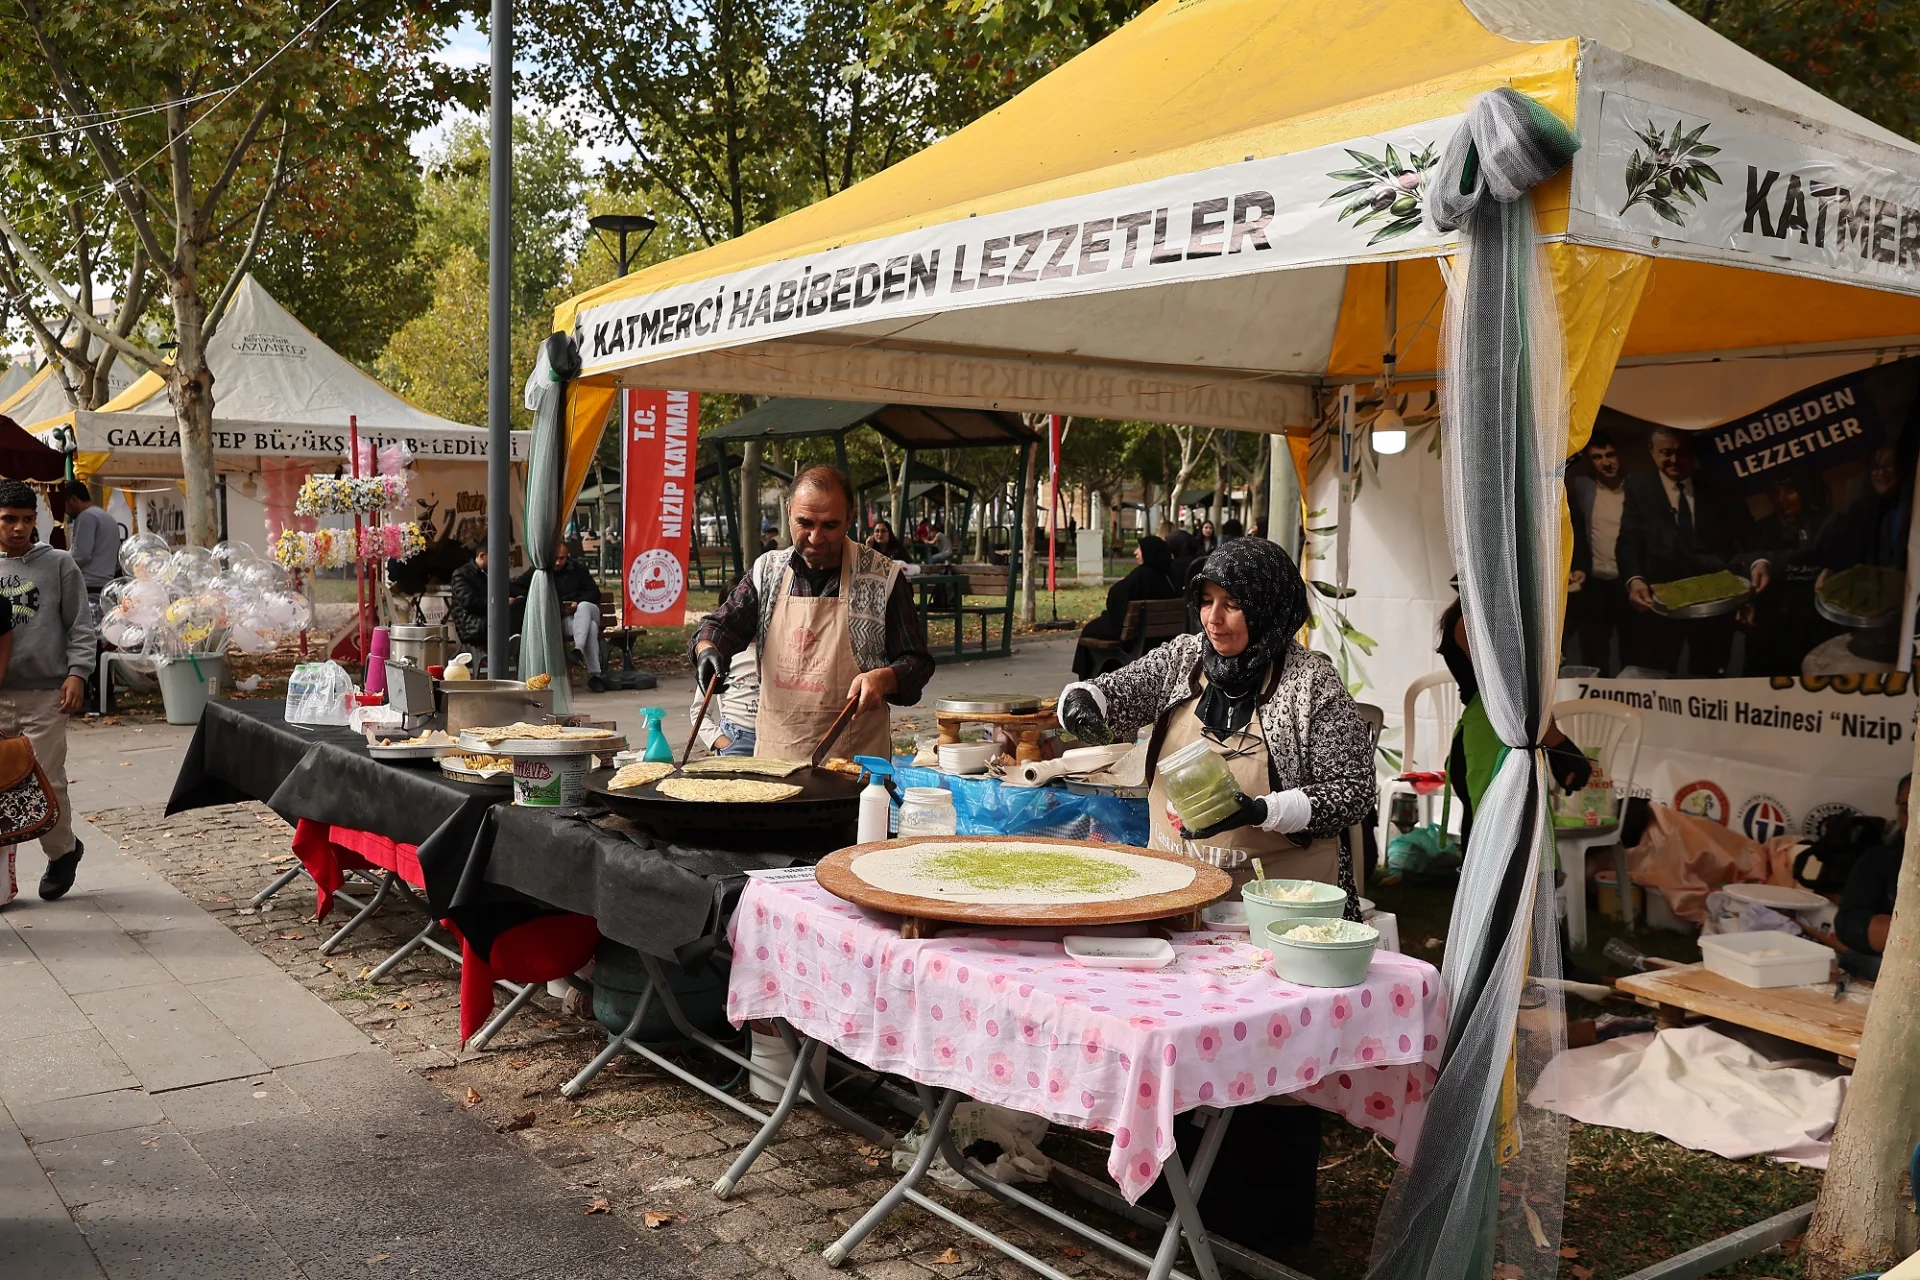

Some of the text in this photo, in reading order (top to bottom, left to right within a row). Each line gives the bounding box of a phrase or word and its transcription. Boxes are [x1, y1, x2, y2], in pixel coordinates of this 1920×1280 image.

[593, 190, 1276, 358] KATMERCİ HABİBEDEN LEZZETLER
[107, 425, 247, 449] GAZİAEP
[634, 404, 656, 441] T.C.
[1714, 387, 1856, 454] HABİBEDEN
[1732, 417, 1863, 478] LEZZETLER
[658, 481, 685, 538] NİZİP
[1688, 696, 1728, 722] Gizli
[1735, 701, 1823, 733] Hazinesi
